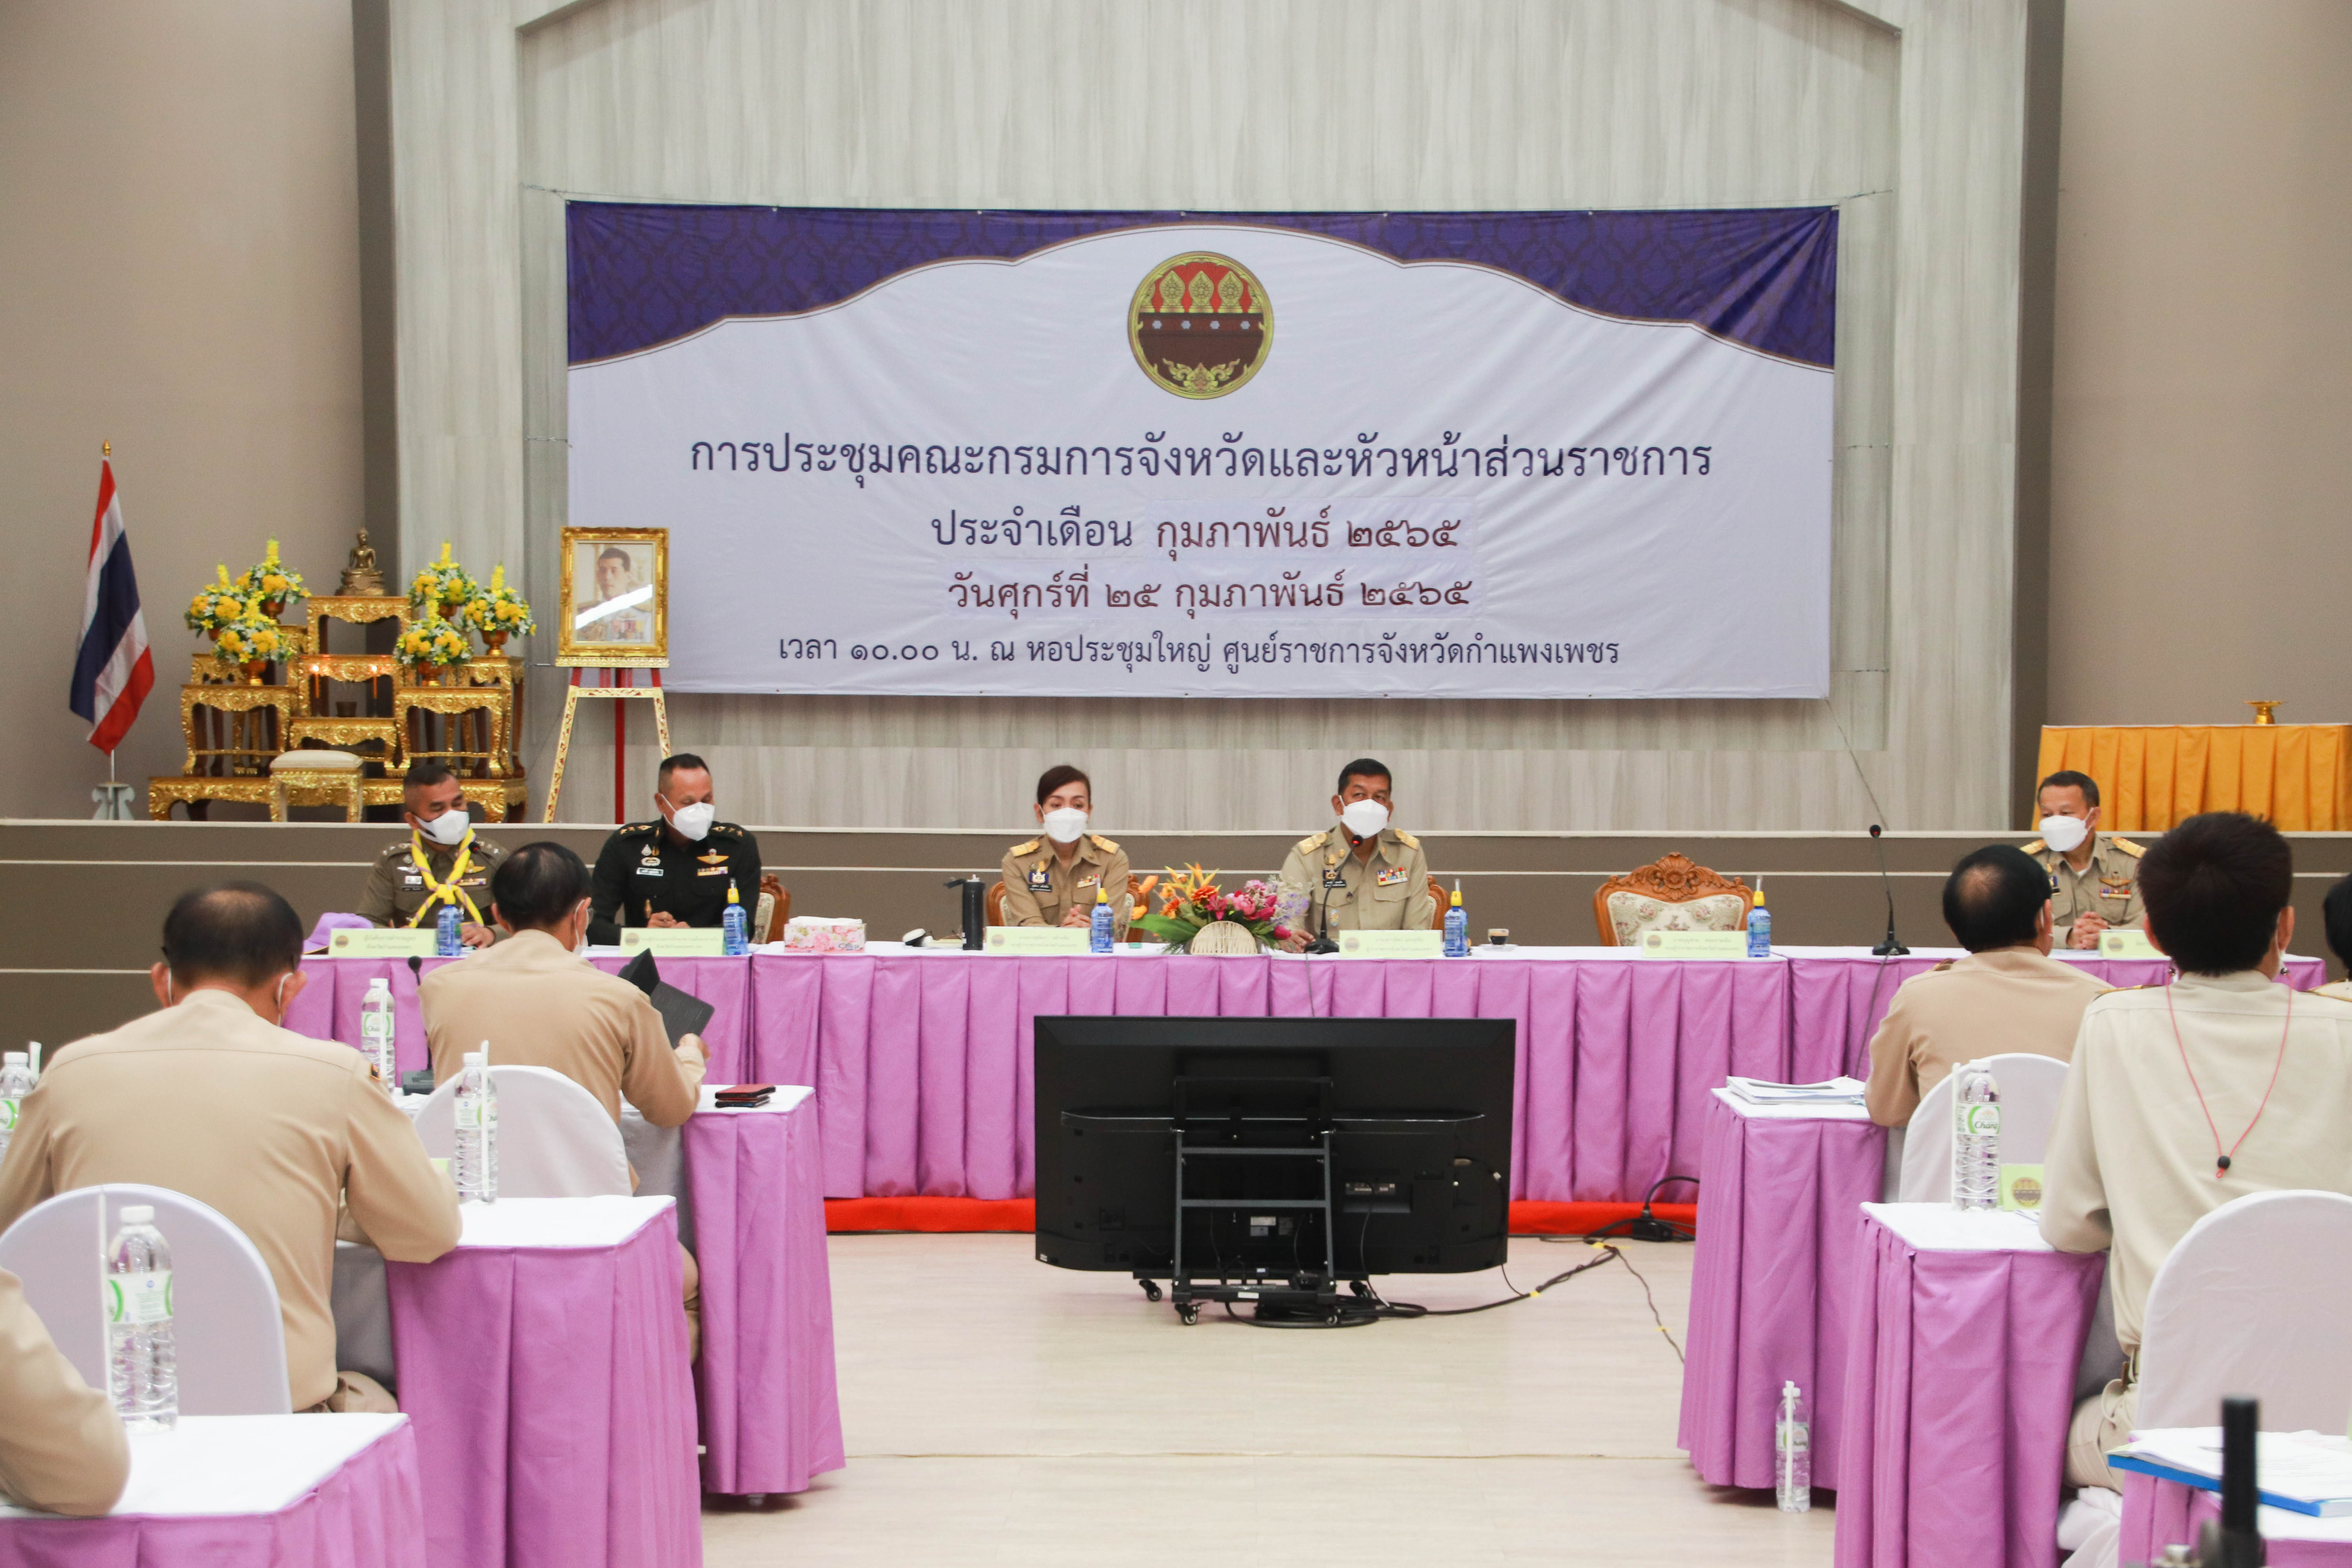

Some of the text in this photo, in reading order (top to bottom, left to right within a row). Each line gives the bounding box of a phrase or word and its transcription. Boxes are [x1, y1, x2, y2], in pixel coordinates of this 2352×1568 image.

[691, 430, 1713, 489] การประชุมคณะกรมการจังหวัดและหัวหน้าส่วนราชการ
[931, 504, 1462, 562] ประจำเดือน กุมภาพันธ์ ๒๕๖๕
[948, 563, 1473, 620] วันศุกร์ที่ ๒๕ กุมภาพันธ์ ๒๕๖๕
[780, 630, 1620, 675] เวลา ๑๐.๐๐ น. ณ หอประชุมใหญ่ ศูนย์ราชการจังหวัดกำแพงเพชร
